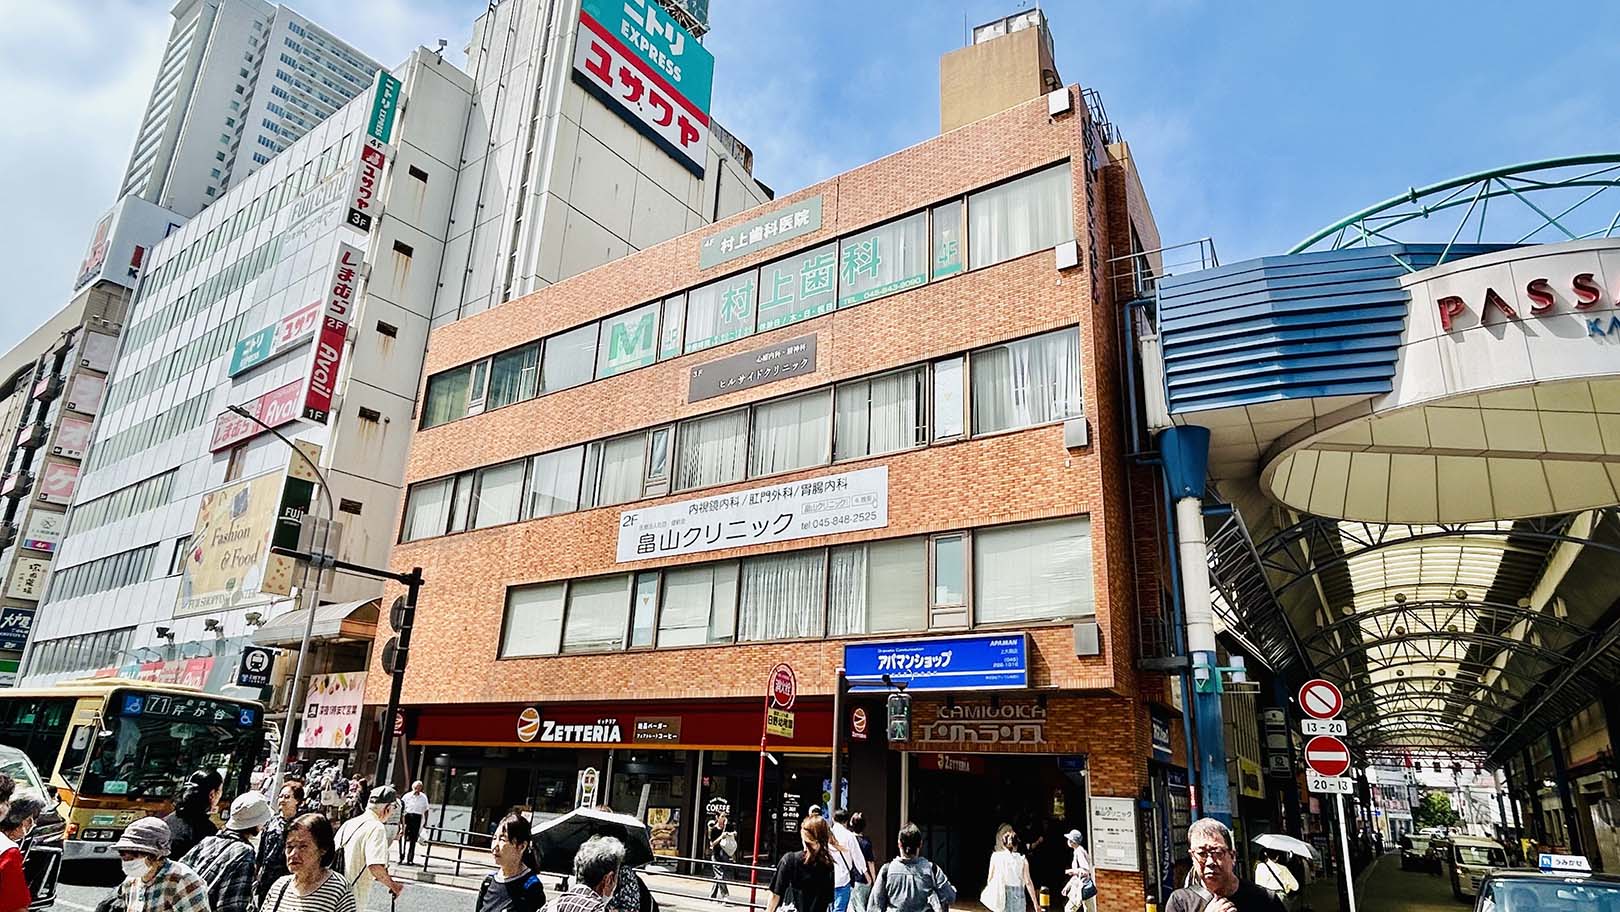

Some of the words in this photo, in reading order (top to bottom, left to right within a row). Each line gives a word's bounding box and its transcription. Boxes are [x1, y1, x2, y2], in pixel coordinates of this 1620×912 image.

[624, 0, 685, 55] ニトリ
[621, 19, 682, 82] EXPRESS
[370, 139, 383, 149] 4F
[351, 212, 367, 227] 3F
[720, 208, 811, 254] 村上歯科医院
[329, 251, 356, 315] しまむら
[719, 236, 883, 325] 村上歯科
[1437, 272, 1620, 333] PASS
[327, 318, 345, 330] 2F
[608, 312, 655, 361] M
[311, 342, 340, 399] Avail
[719, 358, 809, 389] ヒルサイドクリニック
[308, 410, 323, 420] 1F
[211, 518, 251, 547] Fashion
[622, 513, 639, 528] 2F
[637, 512, 794, 555] 畠山クリニック
[231, 540, 261, 568] Food
[877, 649, 953, 671] アパマンショップ
[149, 696, 168, 713] 71
[171, 703, 226, 721] 芹が谷
[540, 720, 622, 743] ZETTERIA
